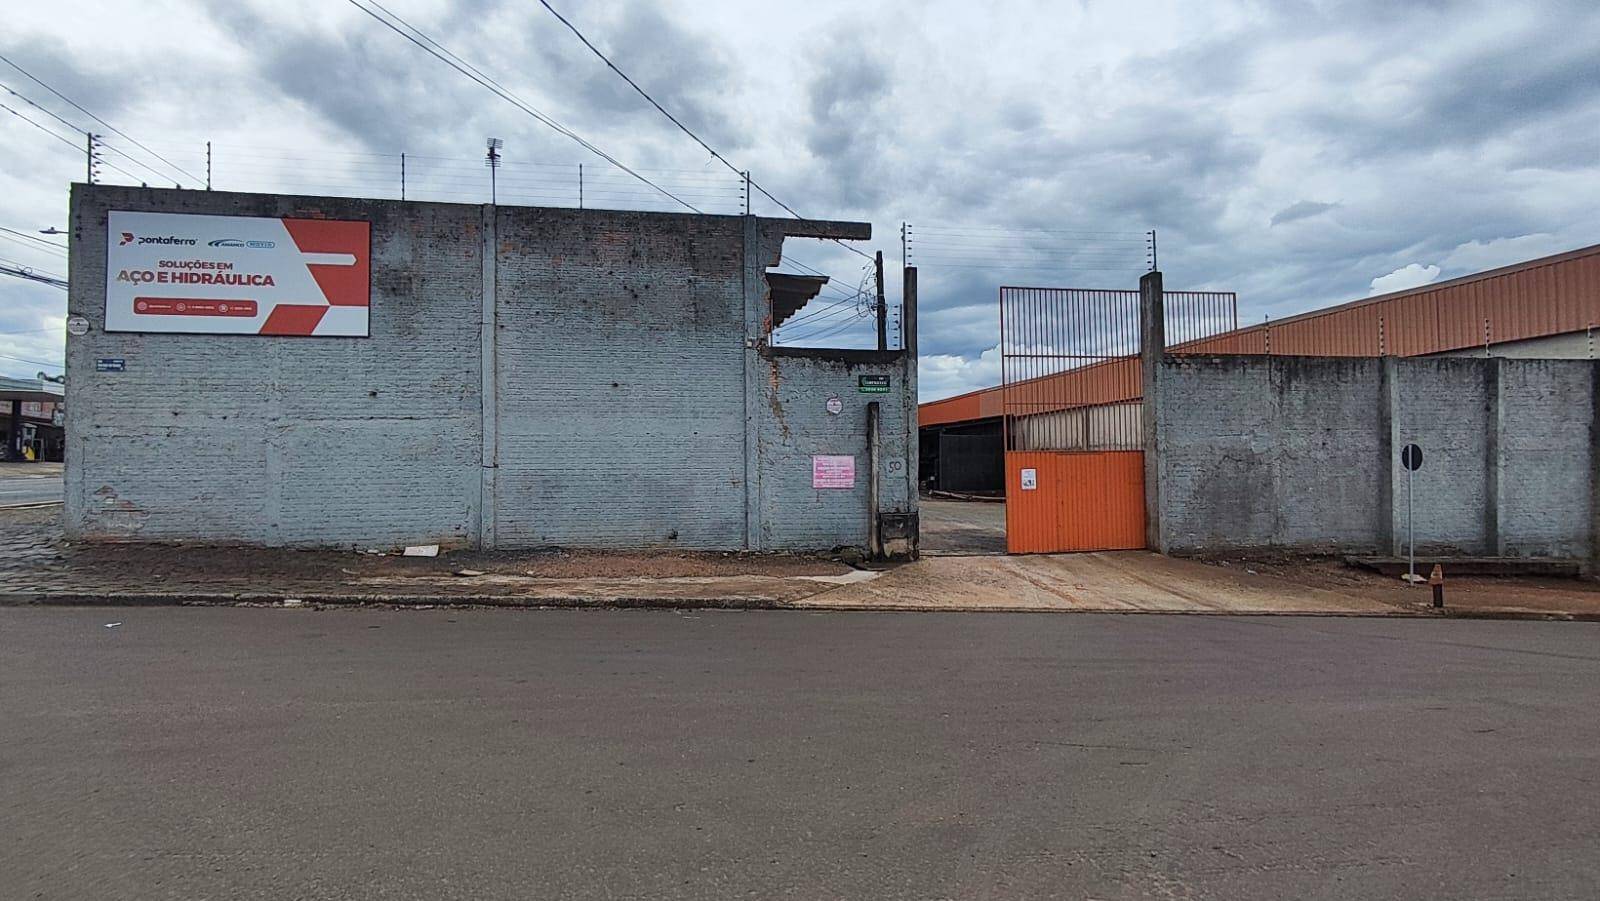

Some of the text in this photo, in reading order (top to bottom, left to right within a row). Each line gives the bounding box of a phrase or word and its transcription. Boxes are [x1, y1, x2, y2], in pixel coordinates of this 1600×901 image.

[138, 236, 196, 246] pontaferro
[158, 260, 234, 270] SOLUÇÕES EM
[116, 270, 275, 286] AÇO E HIDRÁULICA
[889, 461, 902, 473] 50
